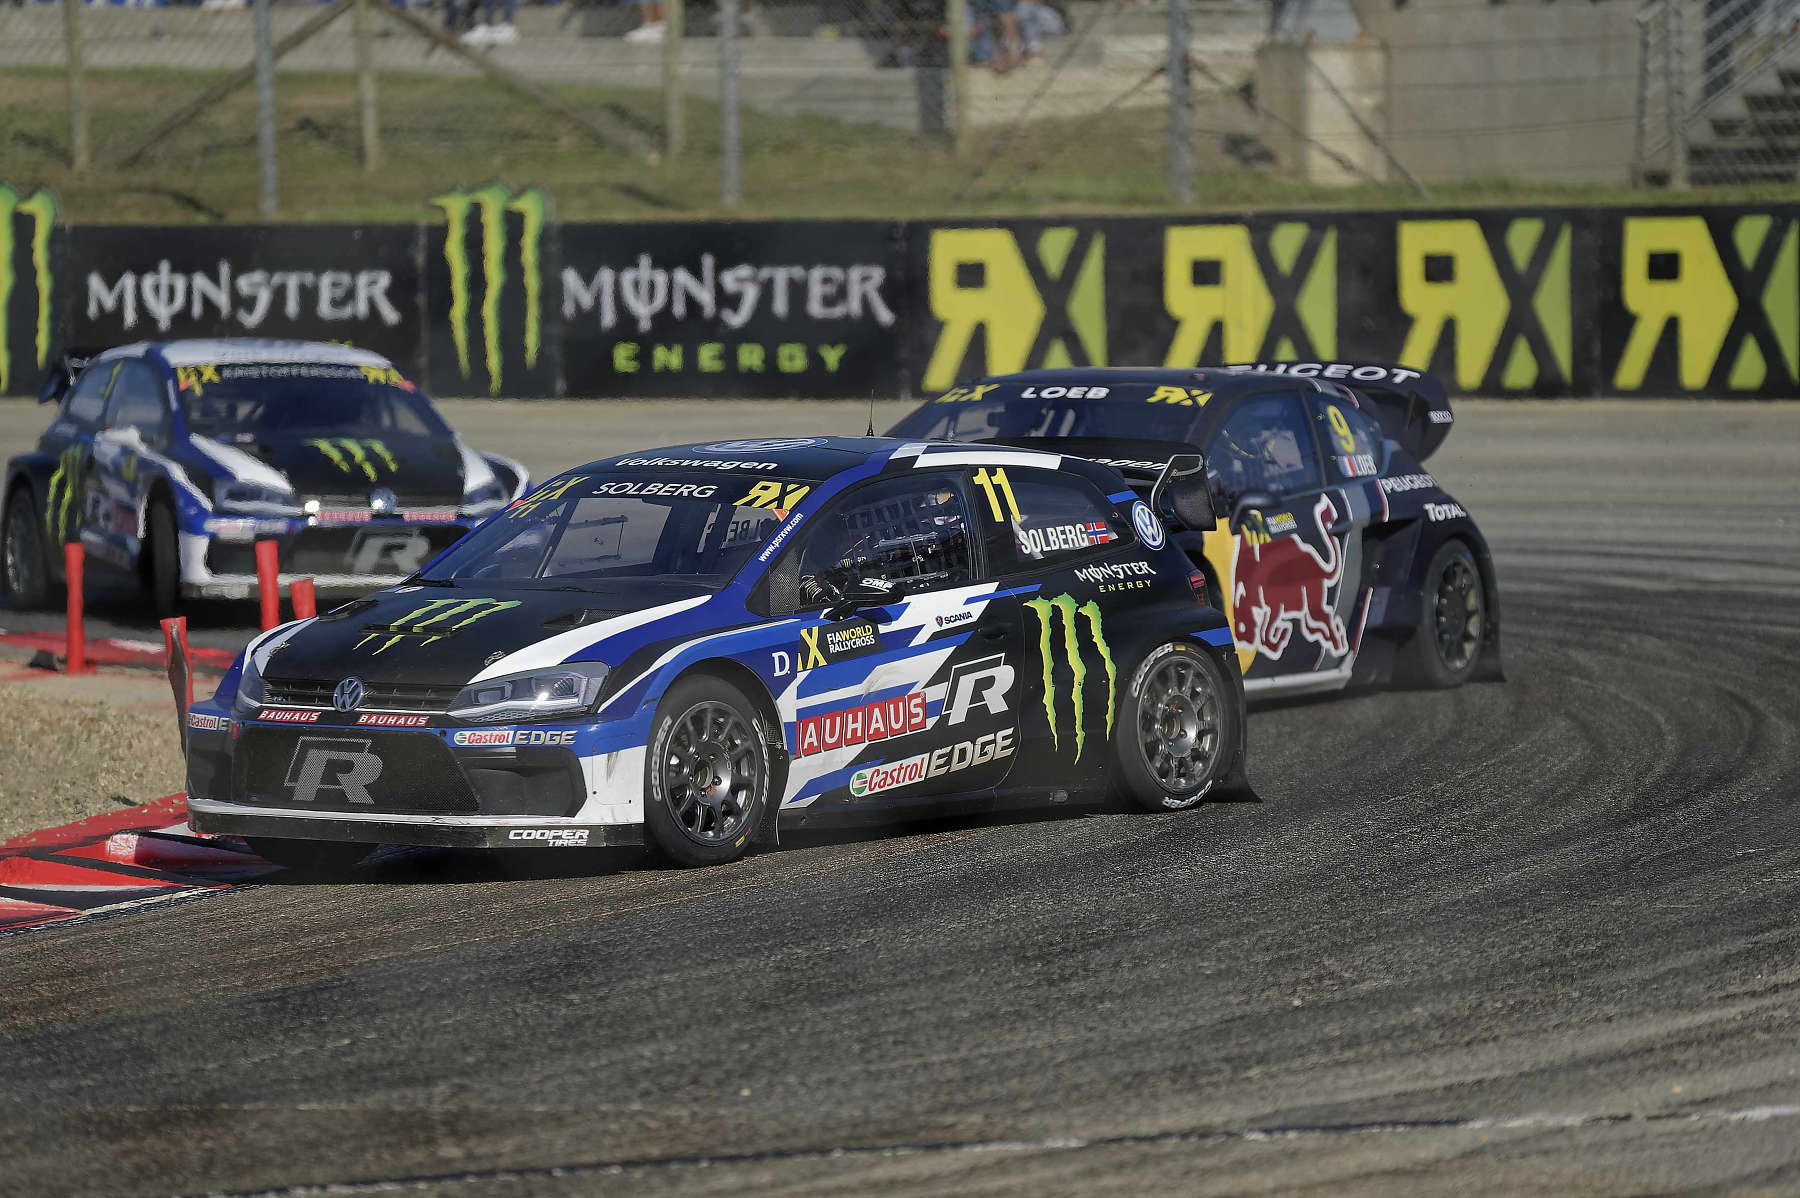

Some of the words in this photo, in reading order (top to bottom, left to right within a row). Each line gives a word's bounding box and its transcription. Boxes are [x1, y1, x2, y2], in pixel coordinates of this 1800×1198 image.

[612, 342, 847, 373] ENERGY
[1021, 386, 1110, 400] LOEB
[1327, 405, 1355, 453] 9
[615, 457, 778, 470] Volkswagen
[592, 482, 718, 498] SOLBERG
[972, 468, 1021, 522] 11
[1018, 523, 1089, 554] SOLBERG
[1074, 561, 1157, 583] MONSTER
[1099, 580, 1152, 593] ENERGY
[944, 611, 973, 625] SCANIA
[829, 635, 876, 654] RALLYCROSS
[260, 710, 320, 722] BAUHAUS
[359, 714, 427, 726] BAUHAUS
[802, 691, 926, 751] AUHAUS
[467, 731, 510, 745] Castrol
[513, 730, 578, 745] EDGE
[868, 761, 925, 792] Castrol
[926, 727, 1016, 779] EDGE
[508, 829, 590, 840] COOPER
[547, 838, 587, 847] TIRES
